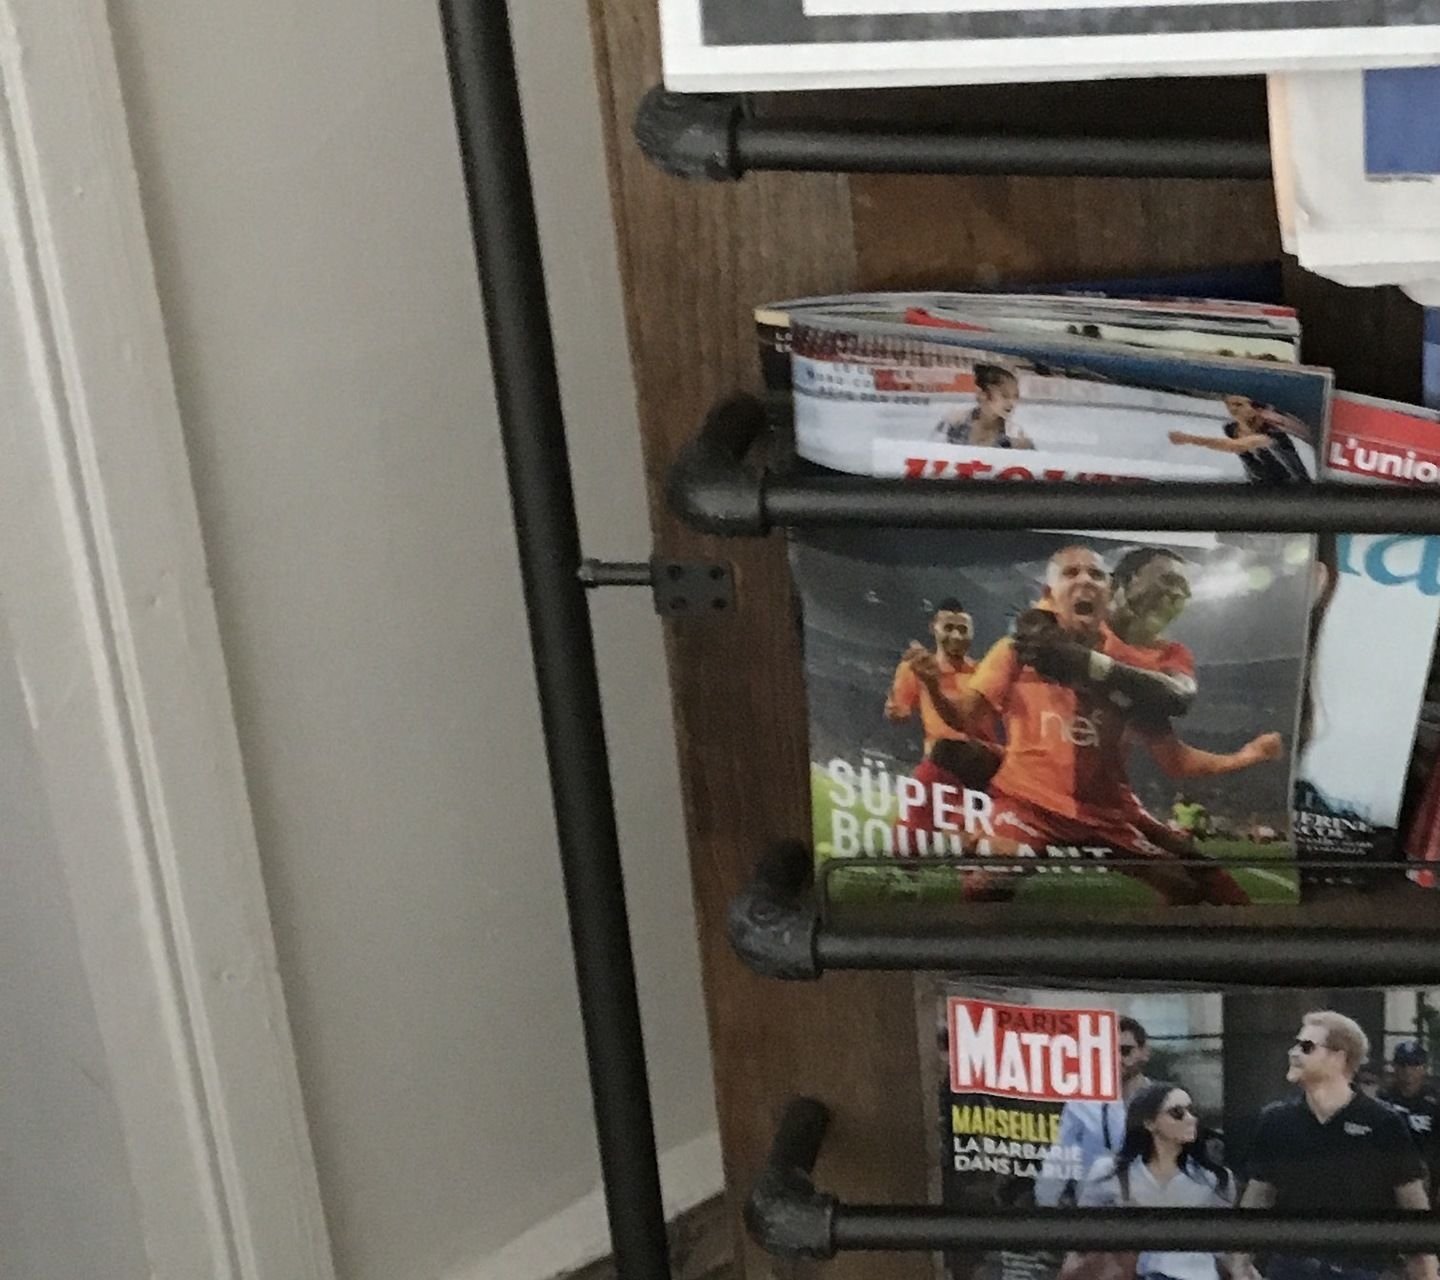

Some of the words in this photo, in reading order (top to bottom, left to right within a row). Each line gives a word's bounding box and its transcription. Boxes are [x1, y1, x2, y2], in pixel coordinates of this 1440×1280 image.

[827, 757, 997, 837] SÜPER
[954, 1003, 1114, 1097] MATCH
[951, 1103, 1061, 1144] MARSEILLE
[953, 1136, 981, 1153] LA
[983, 1136, 1084, 1162] BARBARIE
[954, 1154, 1012, 1175] DANS
[1013, 1158, 1039, 1178] LA
